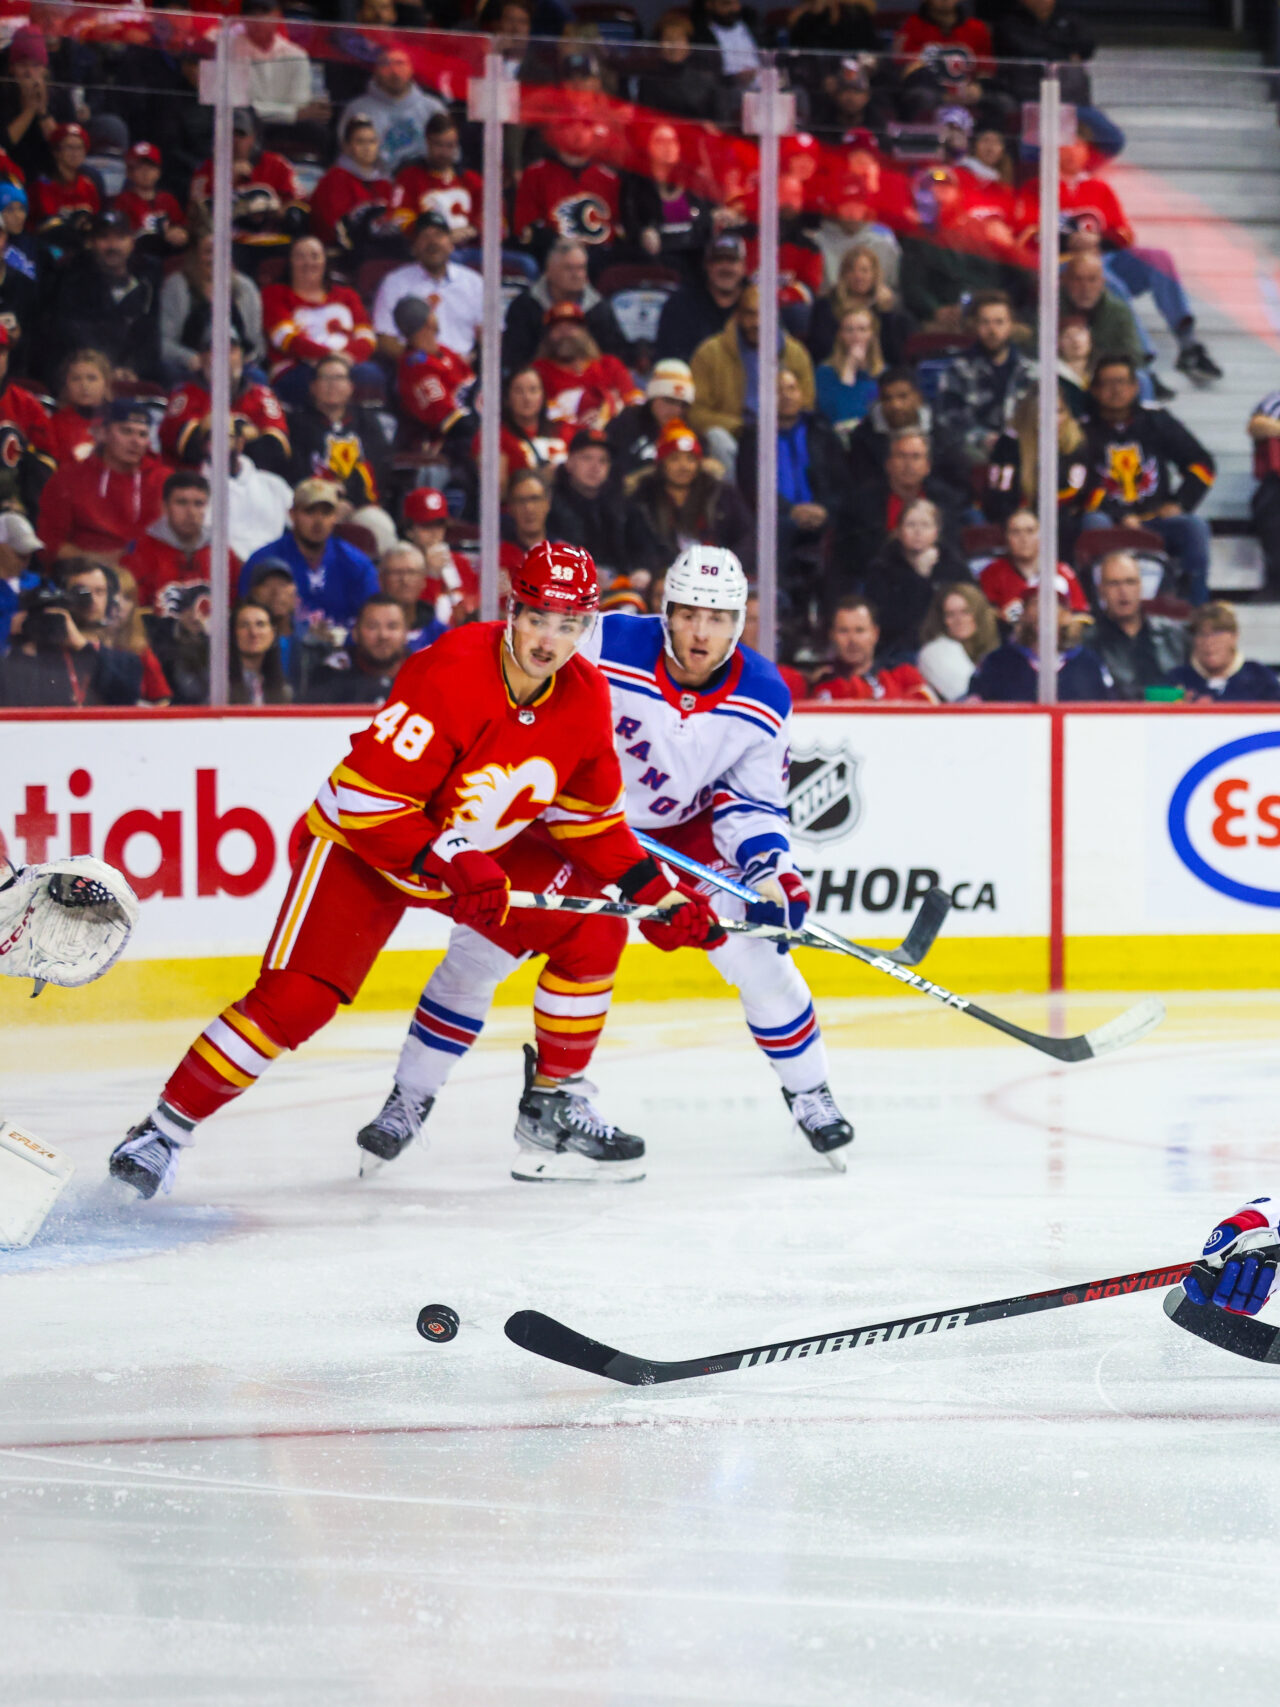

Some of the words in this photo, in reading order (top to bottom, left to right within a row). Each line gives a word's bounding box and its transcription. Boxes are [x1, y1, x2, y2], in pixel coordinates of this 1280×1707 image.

[551, 564, 575, 581] 48
[701, 565, 719, 576] 50
[373, 700, 436, 762] 48
[789, 763, 849, 828] NHL
[0, 768, 319, 902] tiab
[871, 956, 969, 1010] BAUER
[738, 1311, 970, 1370] WARRIOR
